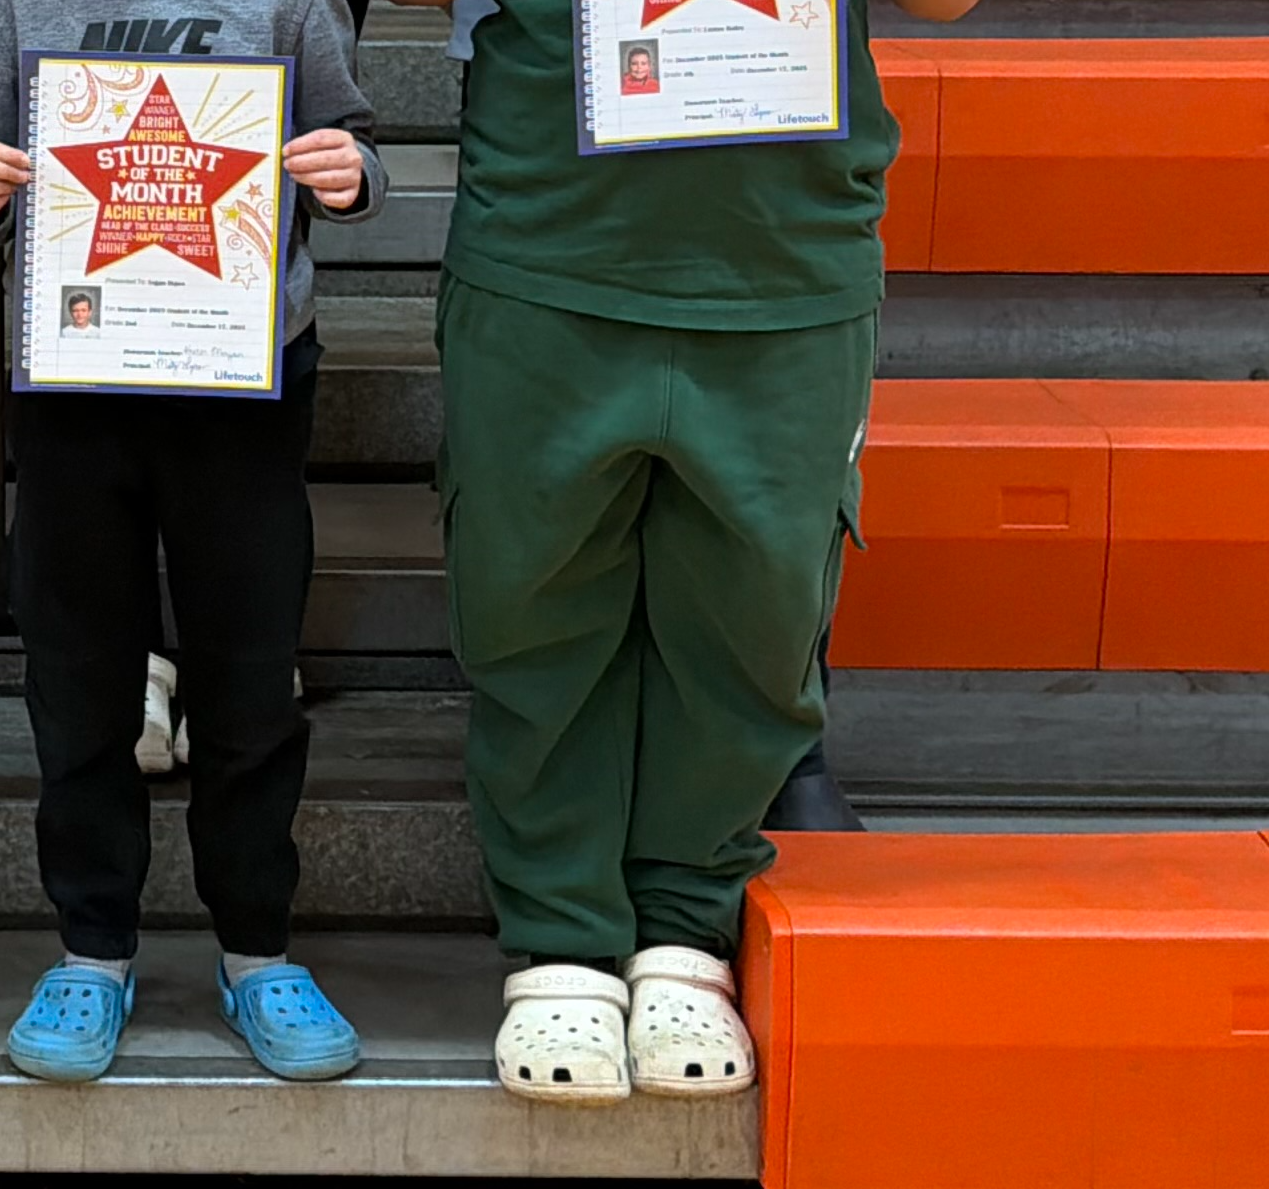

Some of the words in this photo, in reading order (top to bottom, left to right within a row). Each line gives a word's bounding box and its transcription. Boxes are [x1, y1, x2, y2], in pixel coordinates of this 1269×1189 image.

[79, 17, 223, 55] NIKE
[148, 94, 170, 103] STAR
[138, 115, 179, 128] BRIGHT
[778, 112, 828, 125] Lifetouch
[128, 129, 185, 142] AWESOME
[96, 144, 223, 171] STUDENT
[129, 167, 149, 179] OF
[152, 167, 184, 181] THE
[110, 181, 202, 203] MONTH
[102, 204, 207, 221] ACHIEVEMENT
[95, 242, 128, 253] SHINE
[176, 245, 214, 256] SWEET
[214, 370, 263, 380] Lifetouch
